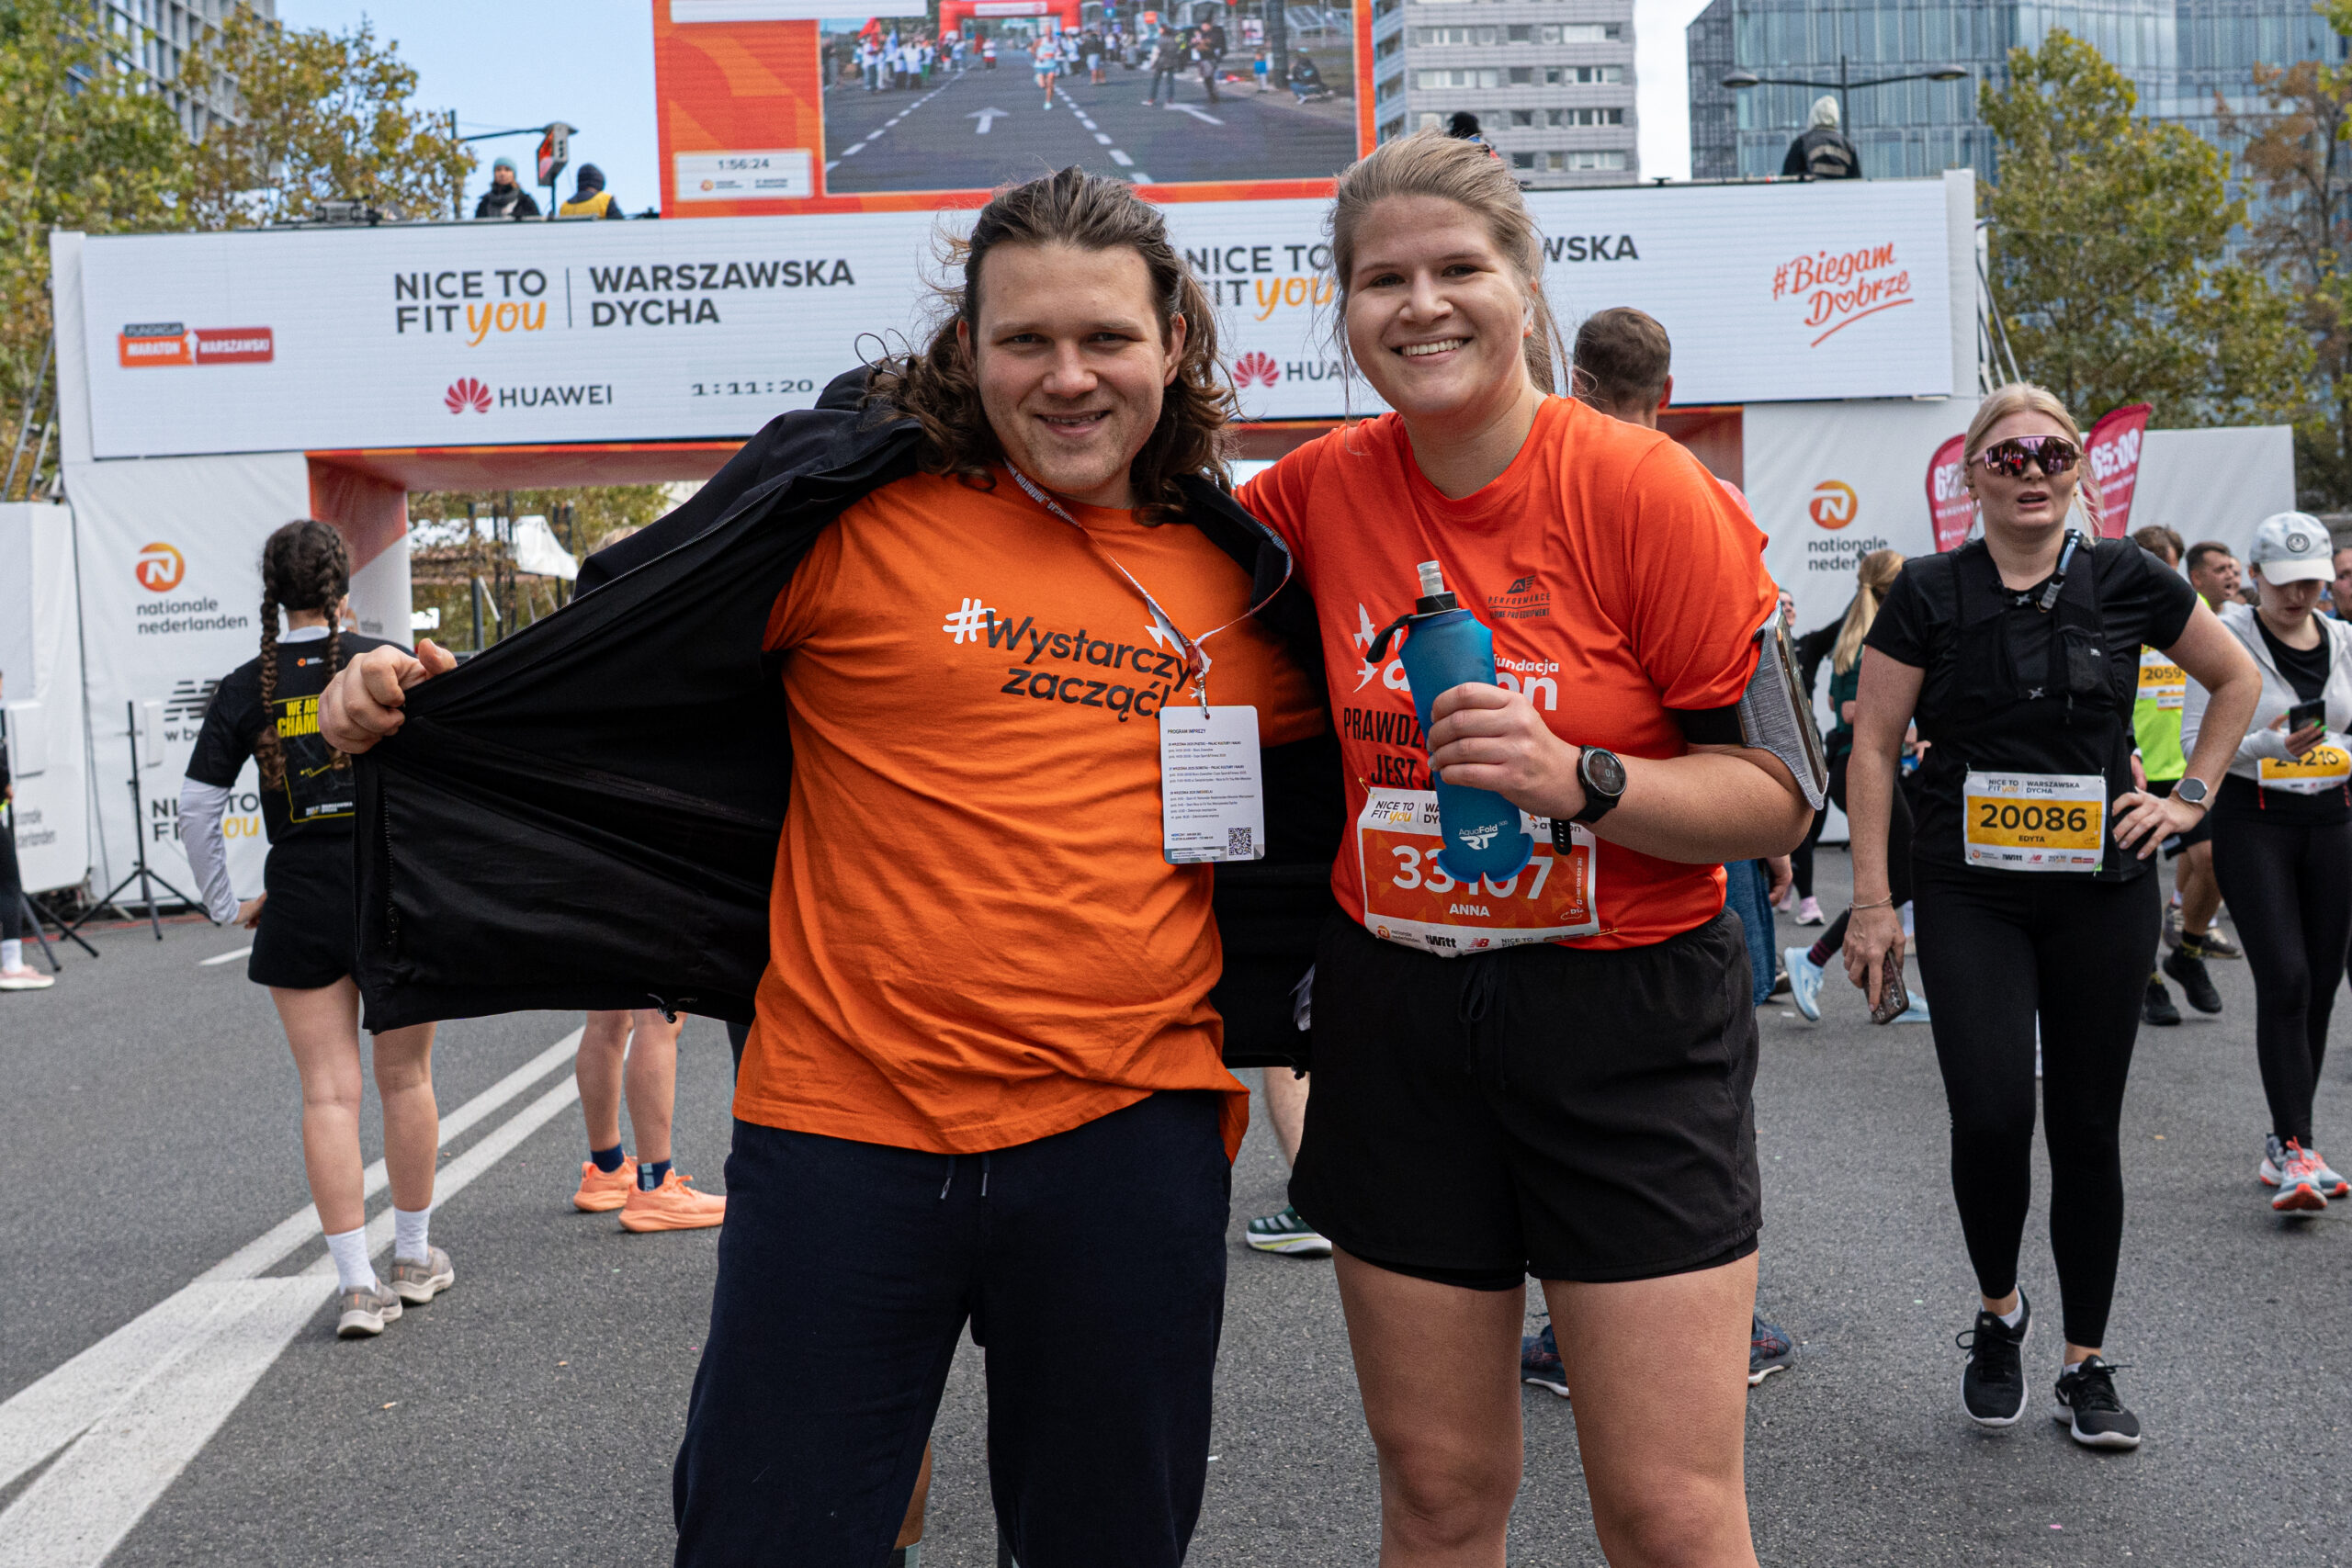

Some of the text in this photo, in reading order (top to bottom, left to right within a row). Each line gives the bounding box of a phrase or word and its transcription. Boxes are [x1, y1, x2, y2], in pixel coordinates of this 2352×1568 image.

[1185, 244, 1332, 275] NICE TO
[395, 267, 547, 301] NICE TO
[589, 258, 854, 294] WARSZAWSKA
[1203, 276, 1334, 321] IT you
[592, 298, 720, 327] DYCHA
[396, 300, 547, 347] FIT you
[127, 338, 270, 356] MARATON WARSZAWSKI
[499, 384, 613, 409] HUAWEI
[691, 379, 818, 396] 1:11:20
[1808, 536, 1888, 552] nationale
[137, 596, 219, 615] nationale
[138, 614, 249, 635] nederlanden
[943, 597, 1192, 693] #Wystarczy
[2145, 668, 2183, 681] 2059
[1001, 667, 1171, 722] zacząć!
[286, 701, 303, 716] WE
[1370, 753, 1418, 788] JEST
[2027, 780, 2080, 789] WARSZAWSKA
[1375, 800, 1414, 811] NICE TO
[1371, 809, 1390, 818] FIT
[1388, 810, 1412, 825] you
[1980, 803, 2087, 832] 20086
[1458, 824, 1498, 837] AquaFold
[2018, 835, 2045, 843] EDYTA
[1449, 903, 1490, 917] ANNA
